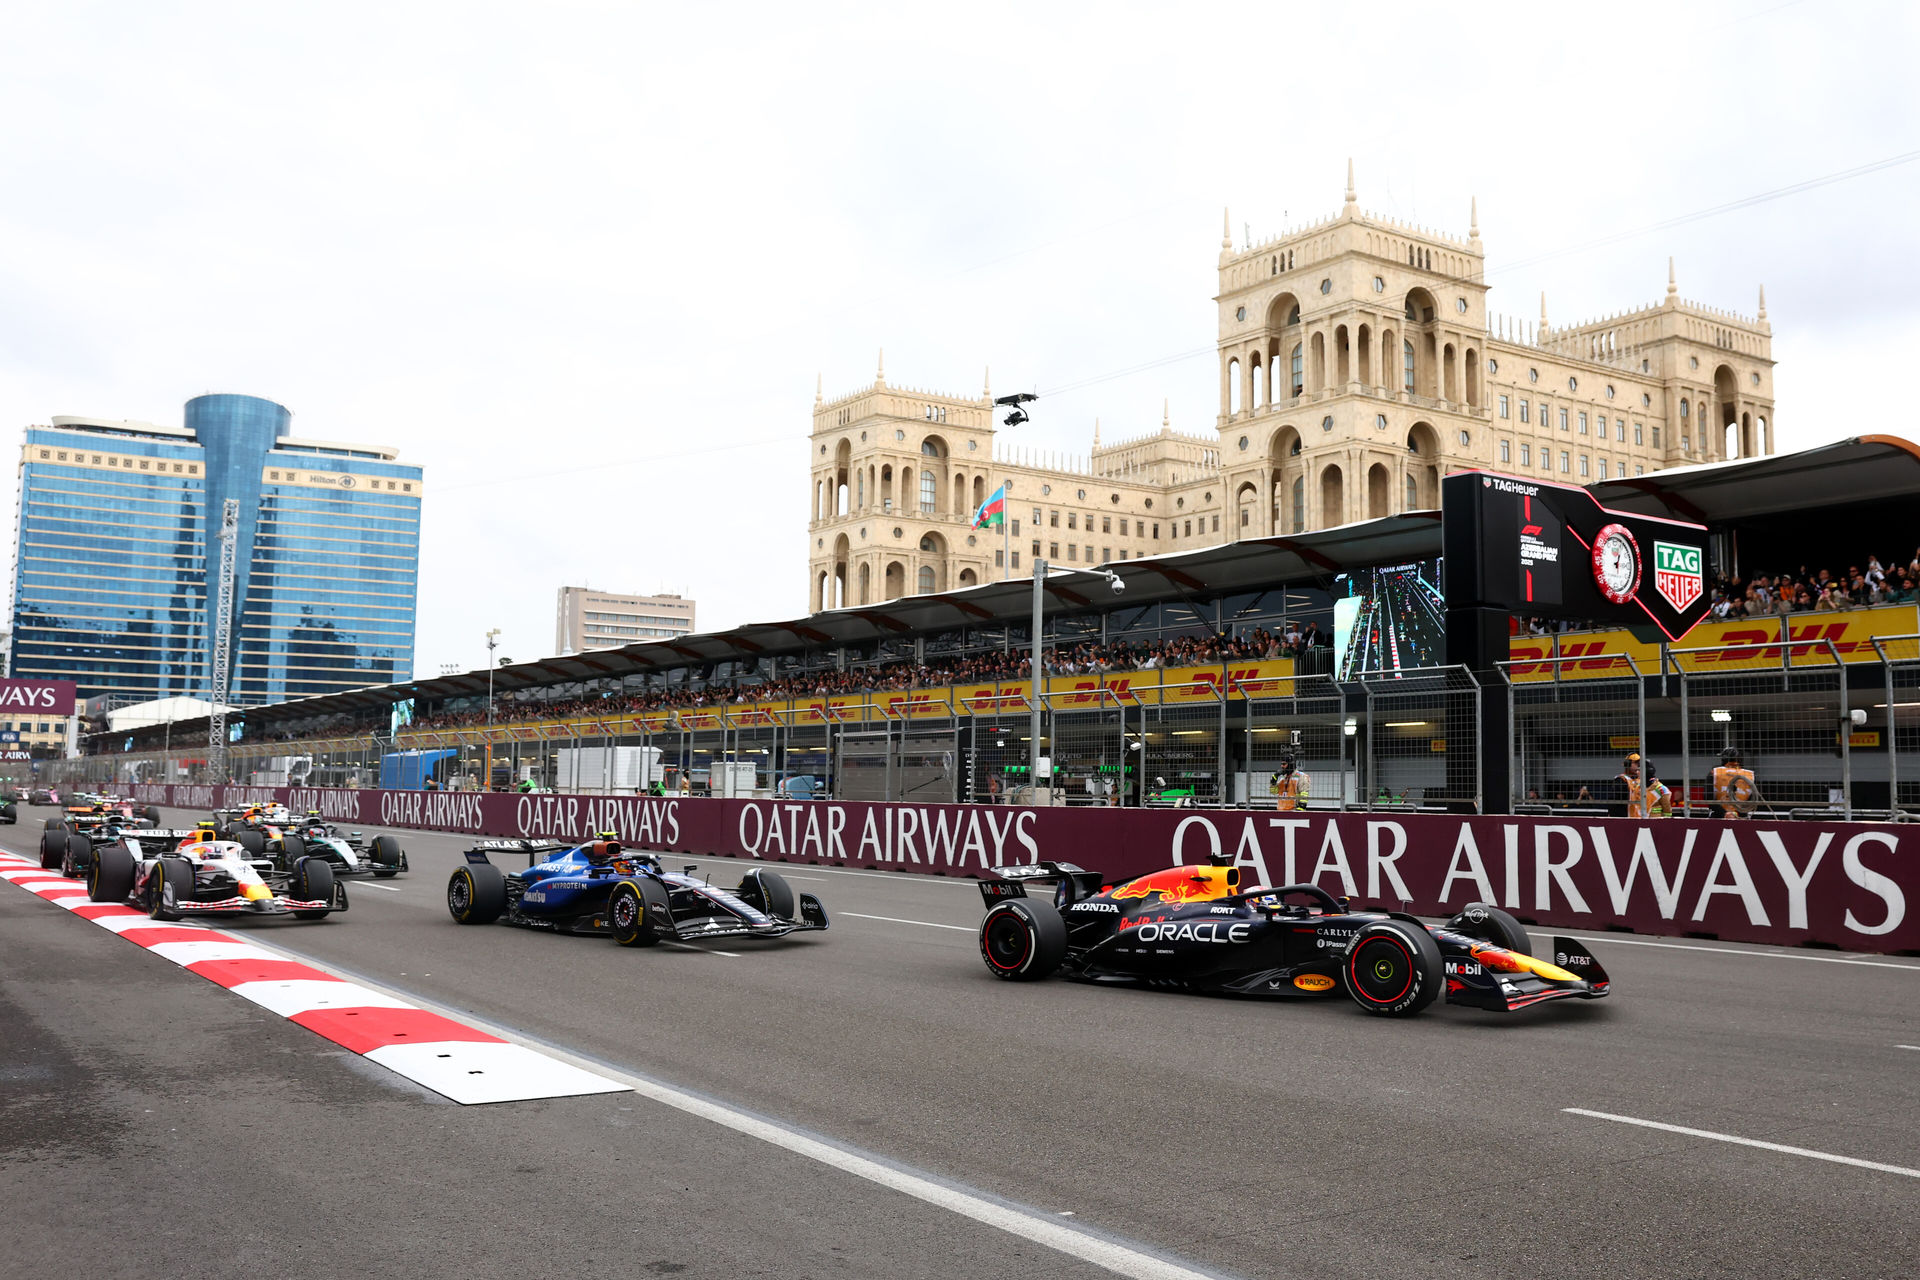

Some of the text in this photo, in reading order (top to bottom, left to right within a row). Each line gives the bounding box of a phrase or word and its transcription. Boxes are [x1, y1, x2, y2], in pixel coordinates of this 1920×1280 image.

[310, 475, 336, 484] Hilton
[1658, 547, 1698, 572] TAG
[1658, 572, 1700, 608] HEUER
[1718, 622, 1859, 662] DHL
[1510, 642, 1614, 675] DHL
[1074, 679, 1133, 703] DHL
[1191, 669, 1265, 695] DHL
[887, 695, 931, 715] DHL
[972, 687, 1025, 709] DHL
[2, 733, 16, 742] FIA
[289, 788, 360, 820] QATAR AIRWAYS
[381, 792, 483, 830] QATAR AIRWAYS
[517, 796, 679, 846] QATAR AIRWAYS
[739, 803, 1038, 869] QATAR AIRWAYS
[1172, 815, 1906, 936] QATAR AIRWAYS
[982, 884, 1013, 895] Mobil
[1071, 903, 1120, 913] HONDA
[1138, 923, 1251, 944] ORACLE
[1326, 940, 1347, 948] 1Passw
[1445, 962, 1482, 976] Mobil
[1569, 955, 1591, 965] AT&T
